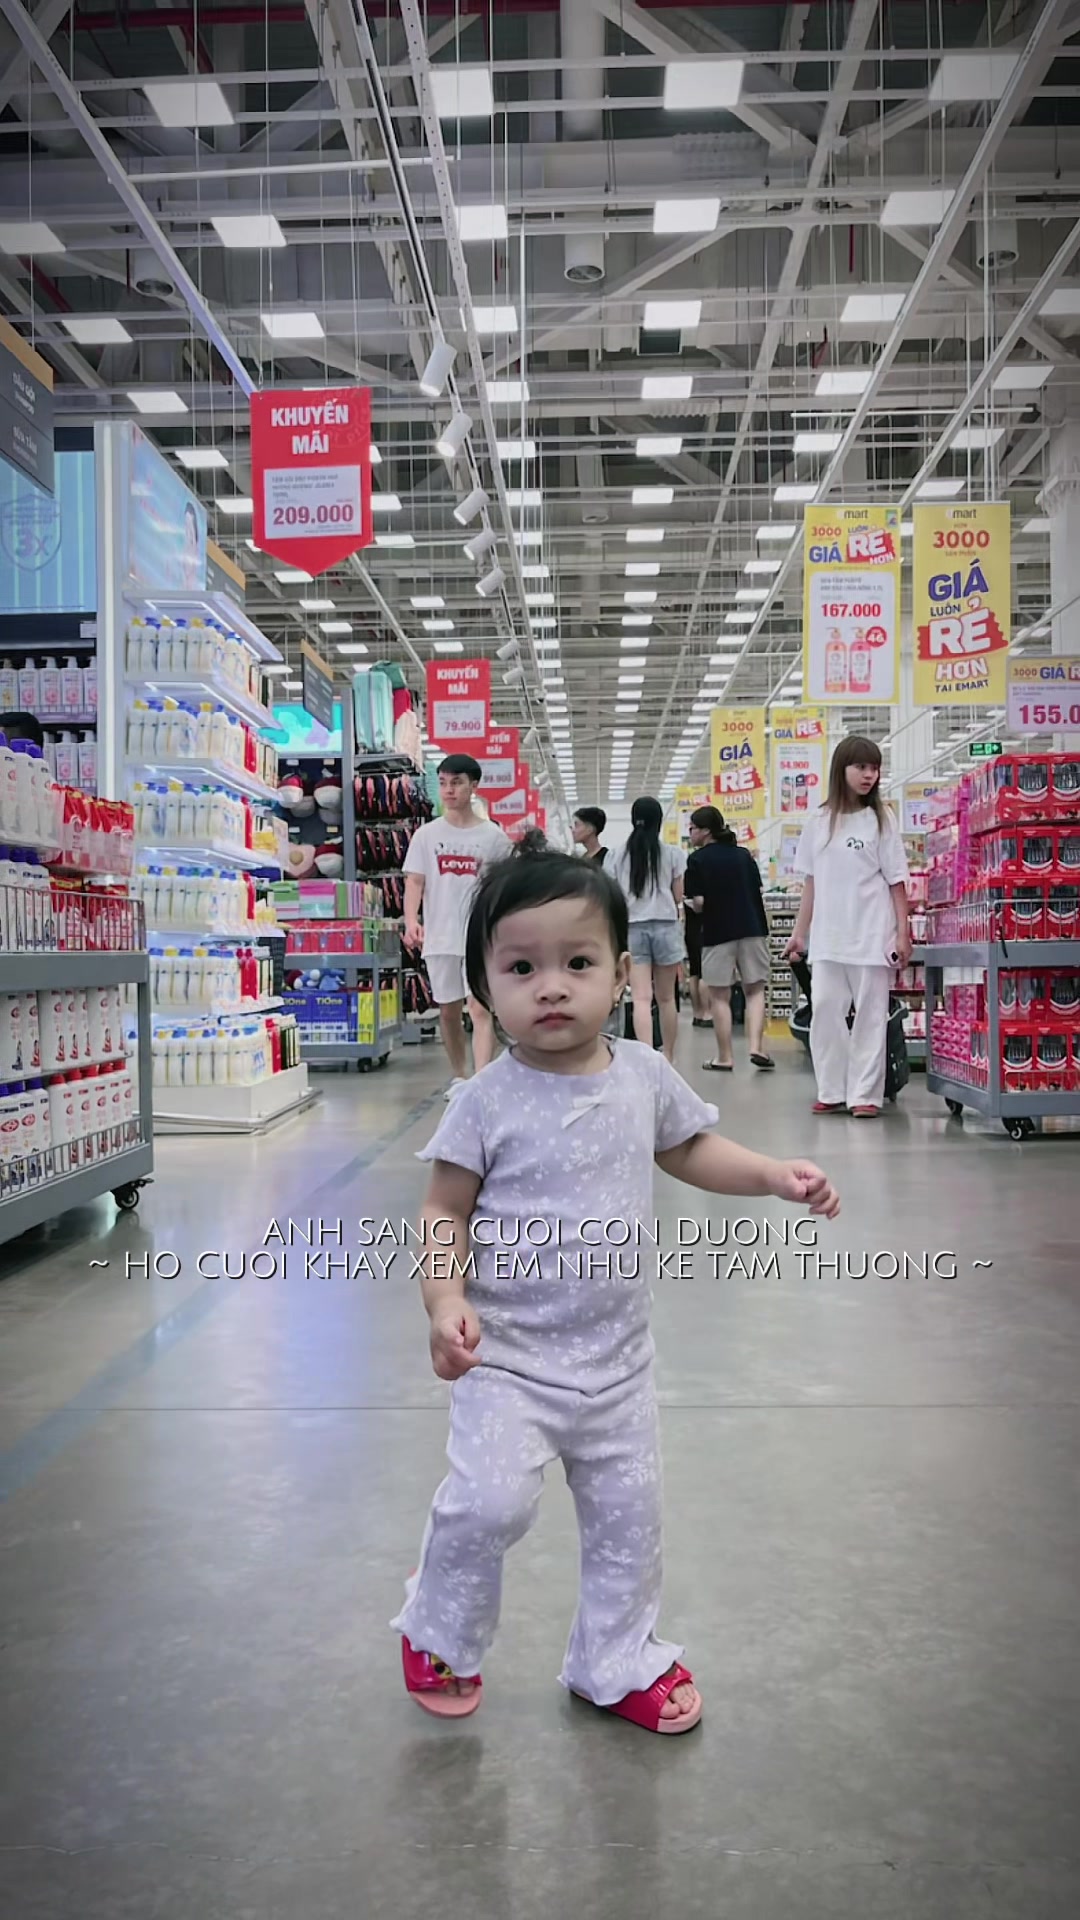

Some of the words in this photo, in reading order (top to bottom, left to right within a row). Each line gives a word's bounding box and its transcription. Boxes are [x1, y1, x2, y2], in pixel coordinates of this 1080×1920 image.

[271, 398, 349, 427] KHUYẾN
[292, 430, 330, 455] MÃI
[273, 504, 354, 526] 209.000
[811, 526, 842, 537] 3000
[932, 529, 990, 548] 3000
[809, 541, 843, 563] GIÁ
[928, 558, 989, 602] GIÁ
[821, 603, 882, 618] 167.000
[930, 602, 961, 617] LUÔN
[929, 596, 992, 656] RẺ
[437, 665, 480, 681] KHUYẾN
[935, 657, 988, 681] HƠN
[1040, 662, 1065, 680] GIÁ
[448, 681, 469, 696] MÃI
[955, 679, 989, 692] EMART
[444, 720, 481, 732] 79.900
[719, 737, 753, 761] GIÁ
